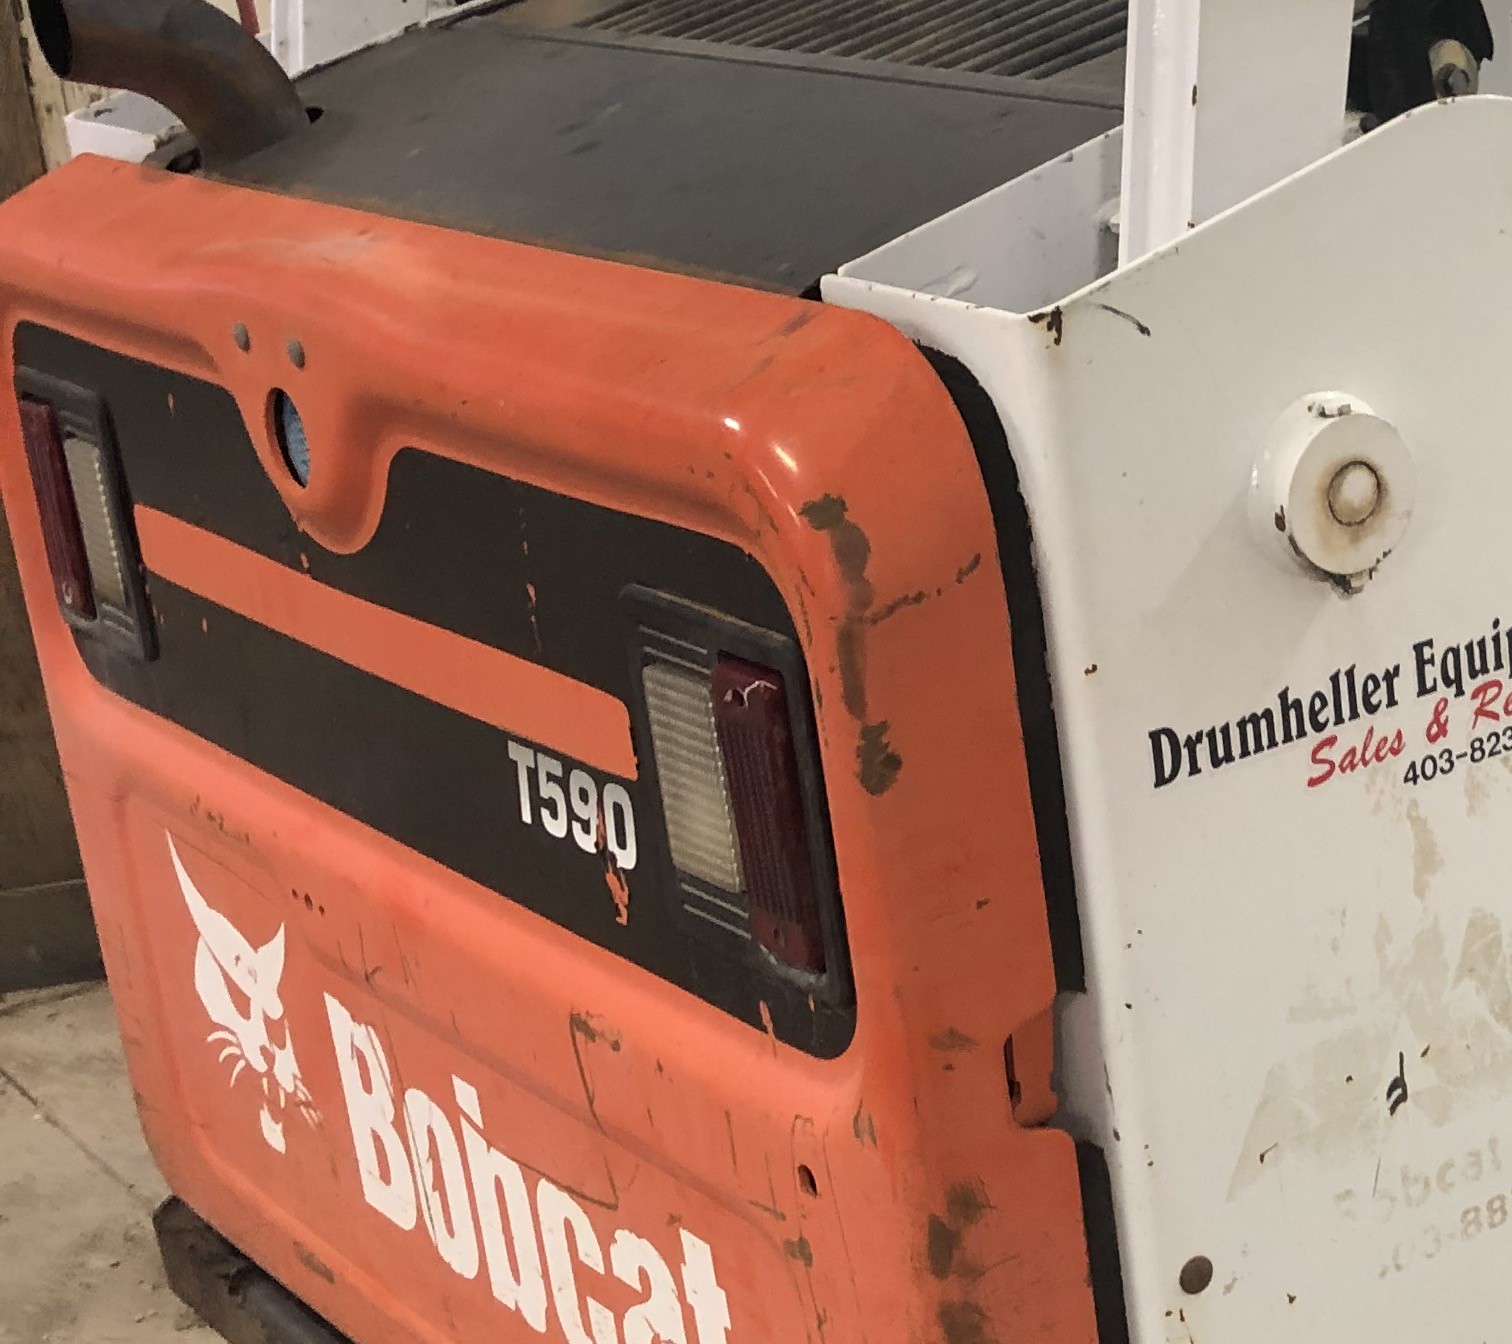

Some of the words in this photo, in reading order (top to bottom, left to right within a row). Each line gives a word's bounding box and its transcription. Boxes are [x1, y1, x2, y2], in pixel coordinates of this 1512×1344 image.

[1148, 664, 1401, 790] Drumheller
[1307, 727, 1405, 789] Sales
[1425, 697, 1449, 744] &
[507, 740, 637, 870] T590
